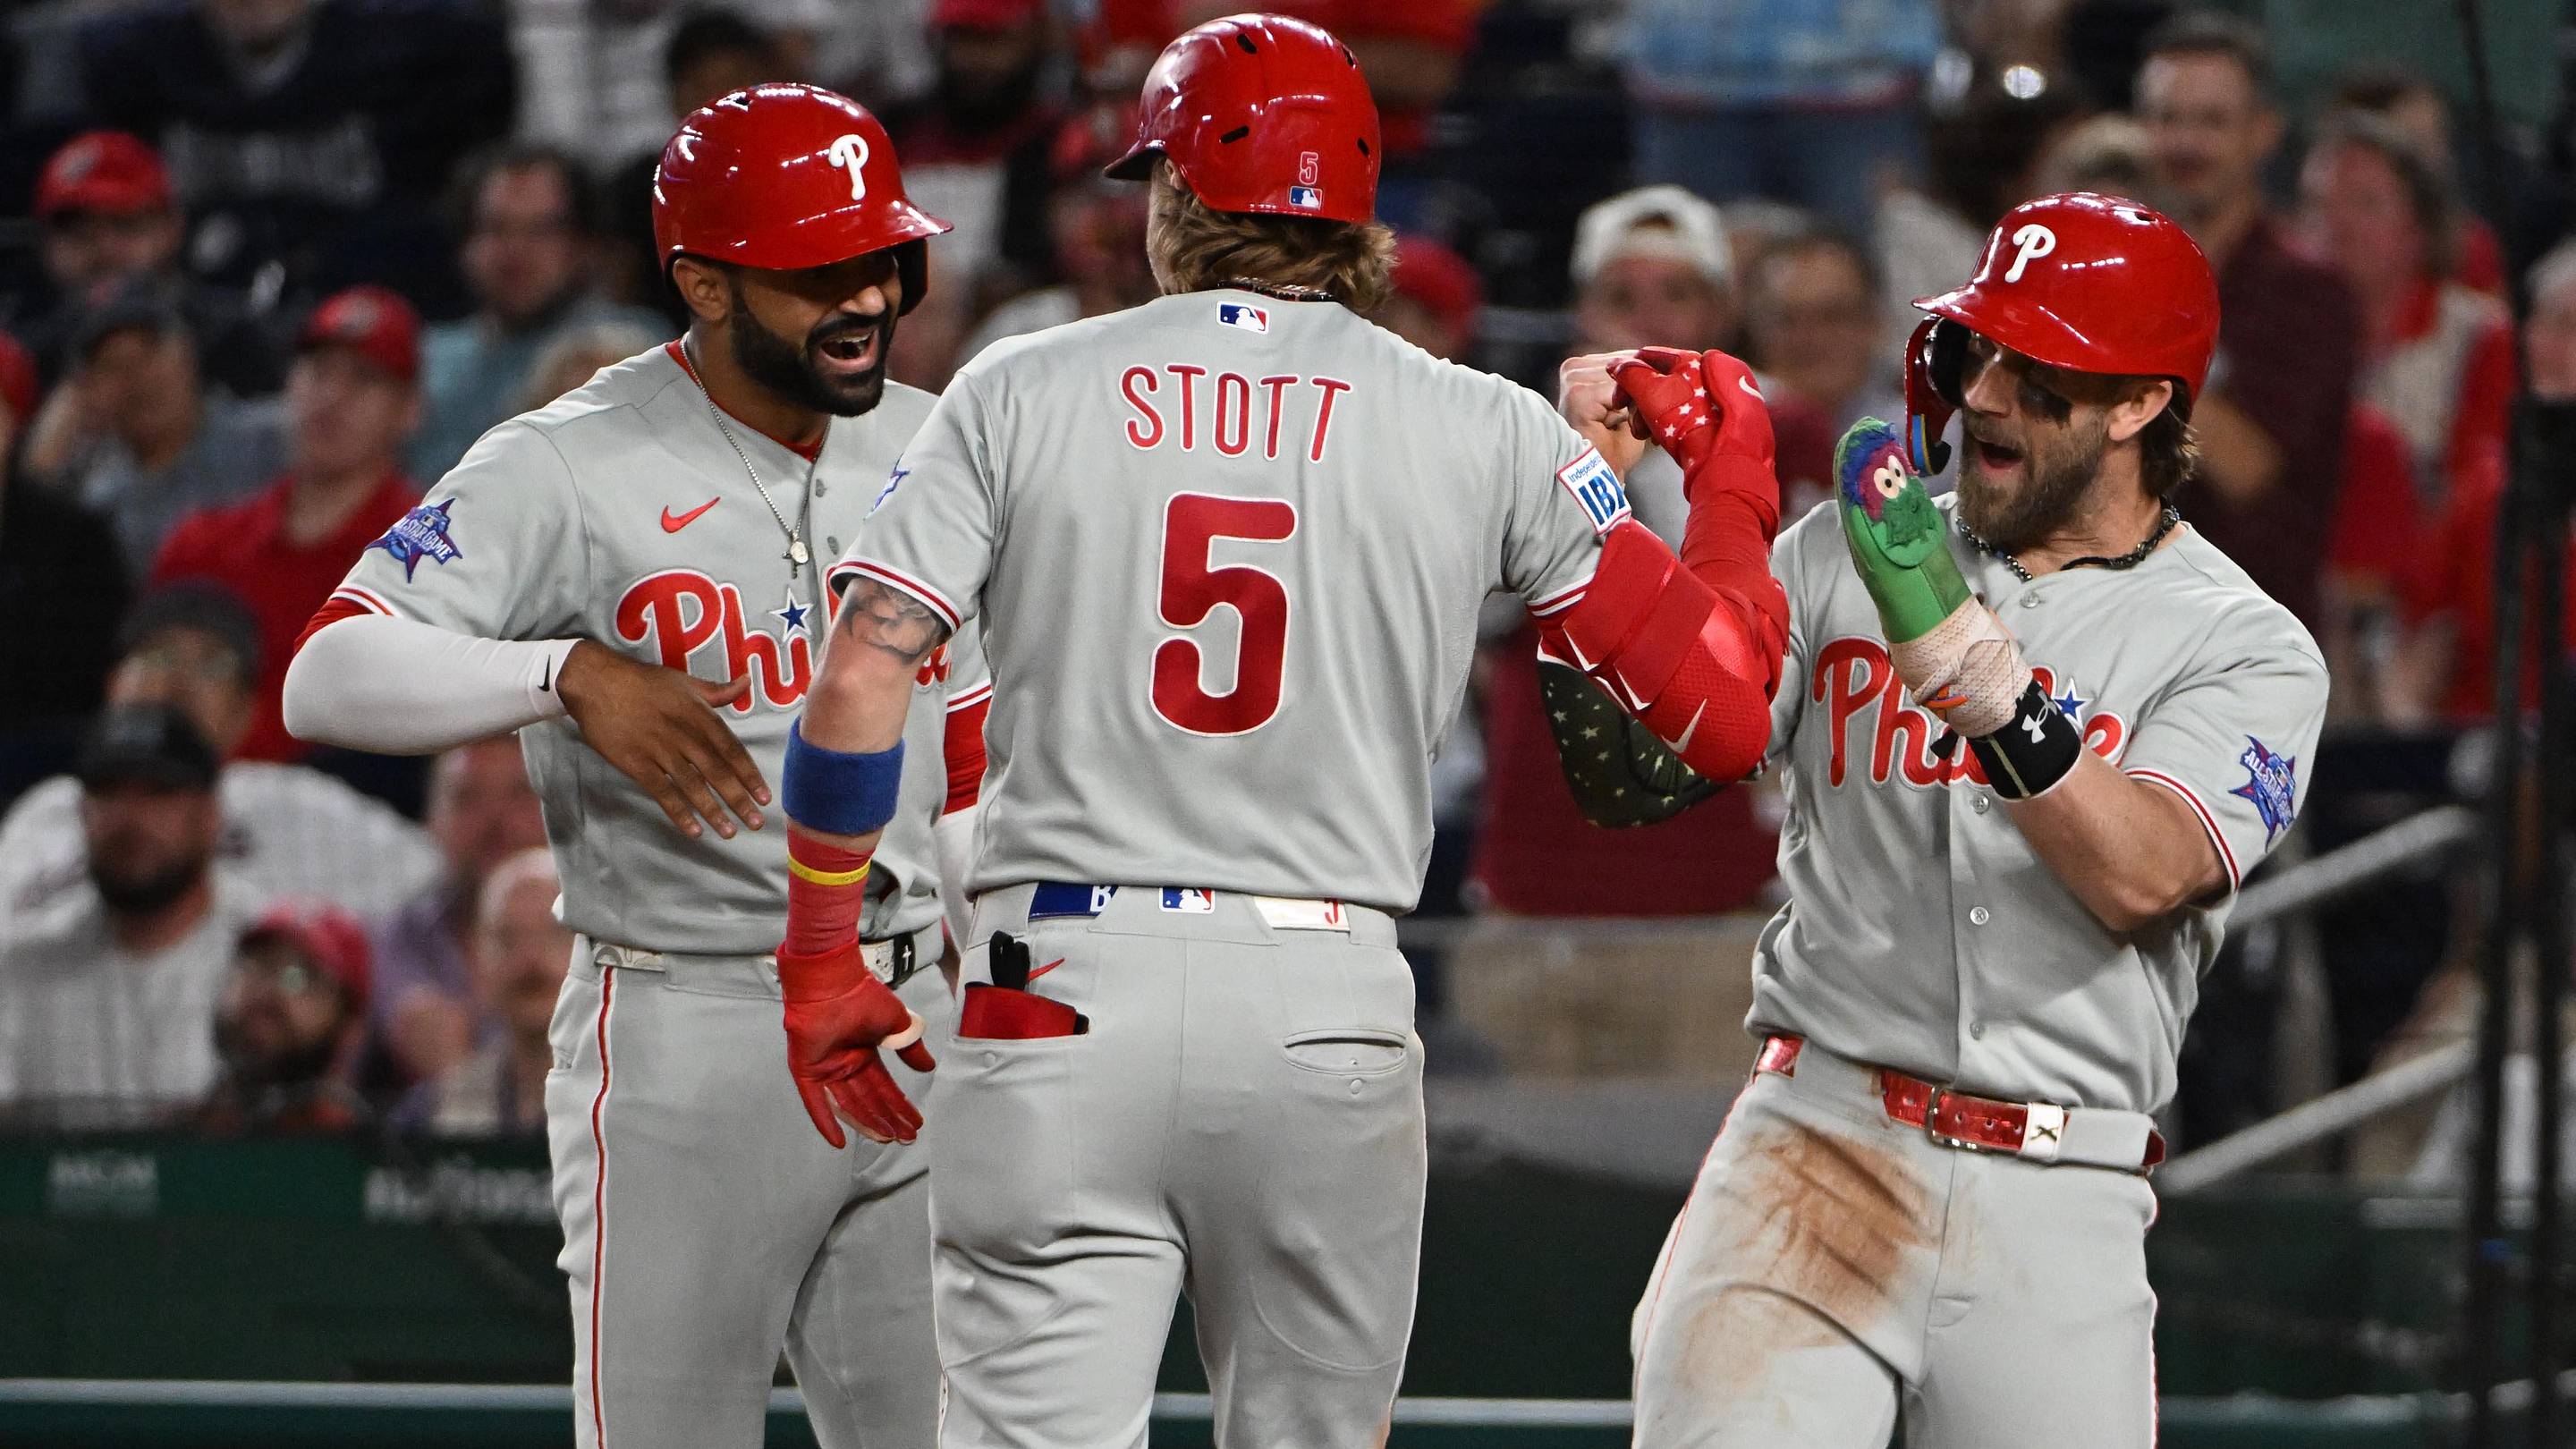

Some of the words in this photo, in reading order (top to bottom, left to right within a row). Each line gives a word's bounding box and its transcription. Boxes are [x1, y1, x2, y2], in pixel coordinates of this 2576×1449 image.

[828, 134, 869, 200] P
[1299, 151, 1319, 185] 5
[2005, 224, 2055, 283] P
[1120, 364, 1353, 463] STOTT
[421, 530, 453, 560] GAME
[1148, 490, 1298, 737] 5
